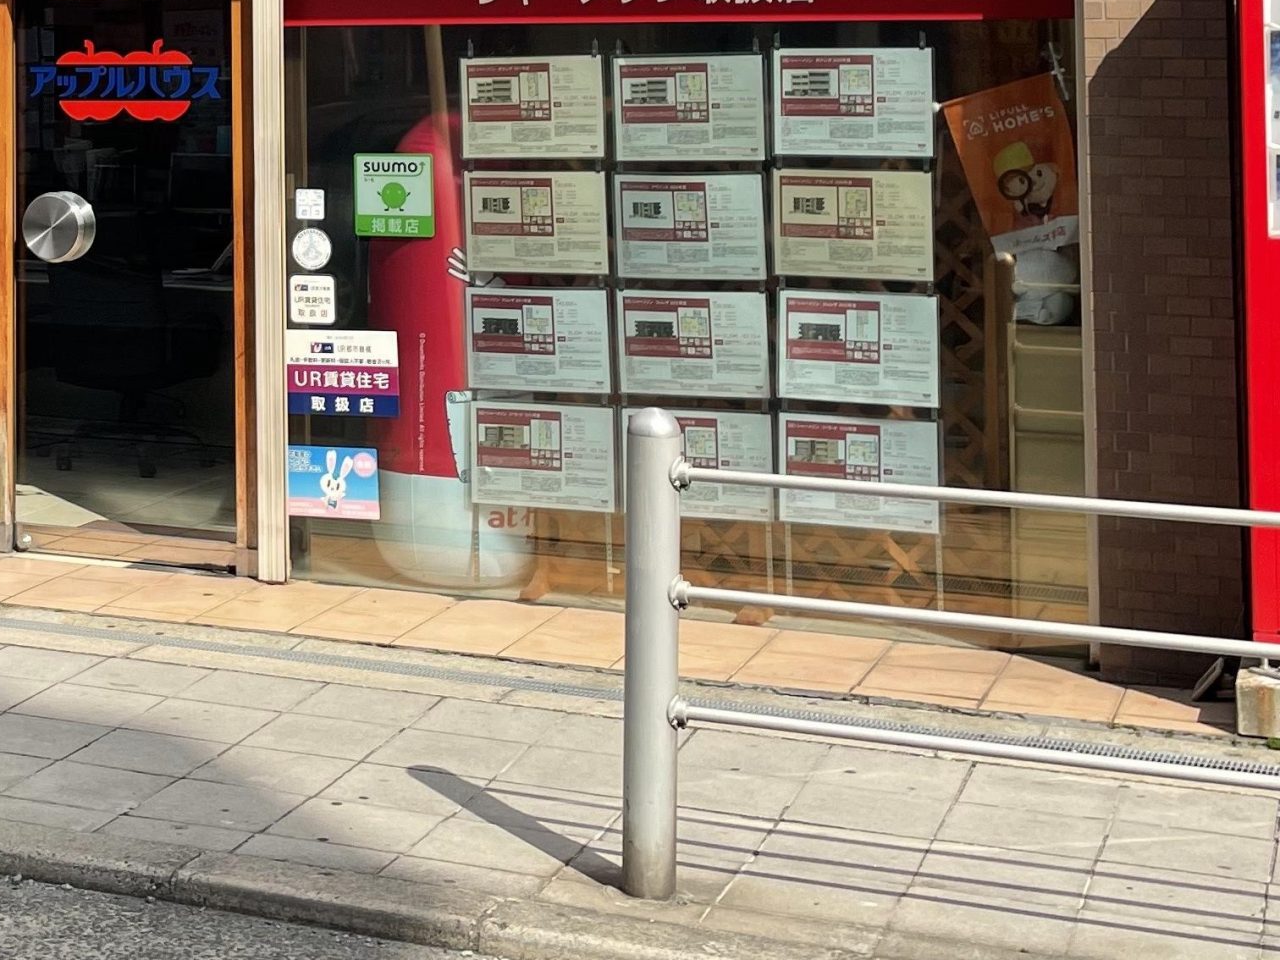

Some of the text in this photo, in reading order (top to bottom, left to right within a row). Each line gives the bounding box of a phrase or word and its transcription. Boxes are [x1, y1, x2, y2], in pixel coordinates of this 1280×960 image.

[29, 65, 222, 100] アップルハウス
[992, 106, 1055, 133] HOME'S
[363, 161, 418, 173] suumo
[370, 218, 419, 234] 掲載店
[294, 370, 390, 389] UR賃貸住宅
[310, 396, 375, 413] 取扱店
